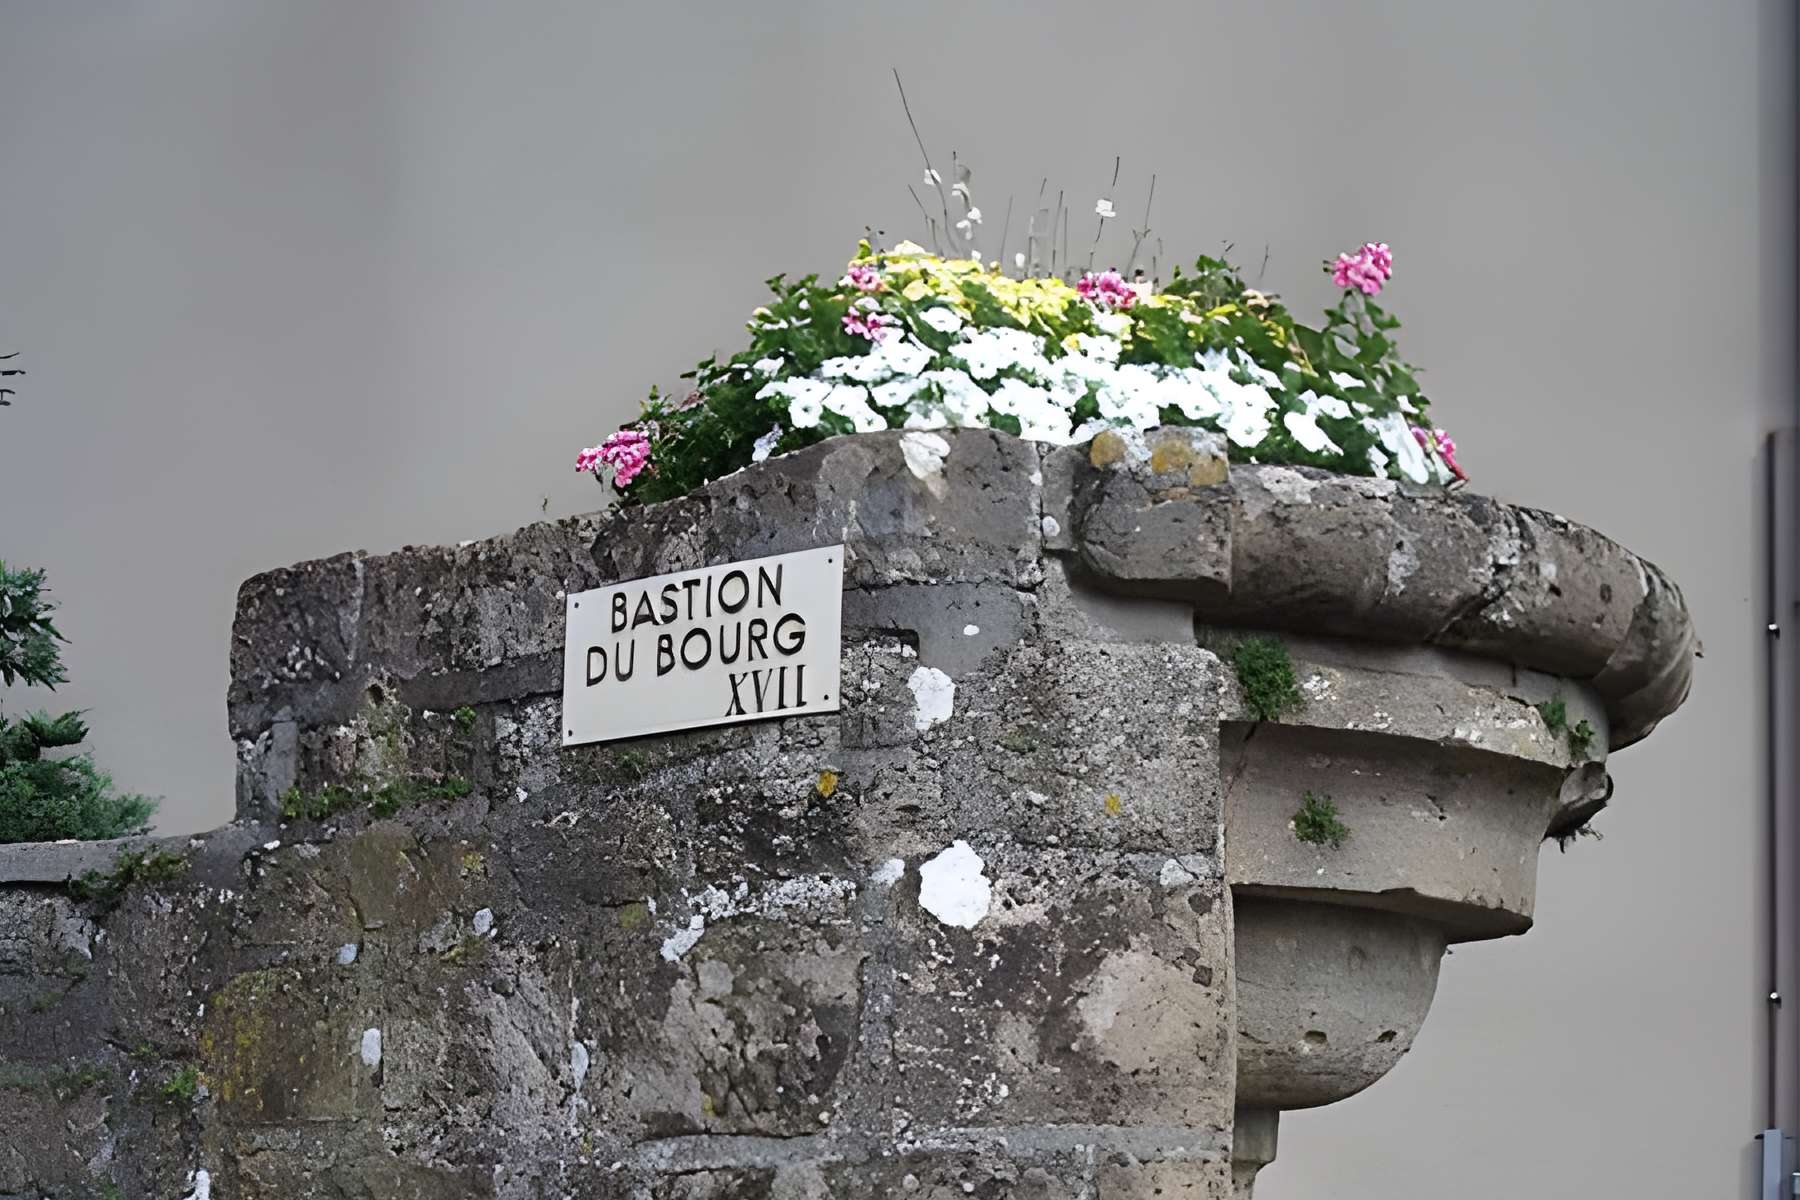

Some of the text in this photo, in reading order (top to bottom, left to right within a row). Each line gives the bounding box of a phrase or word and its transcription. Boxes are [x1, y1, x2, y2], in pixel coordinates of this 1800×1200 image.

[611, 563, 783, 634] BASTION
[586, 612, 806, 688] DU BOURG
[724, 664, 807, 718] XVII
